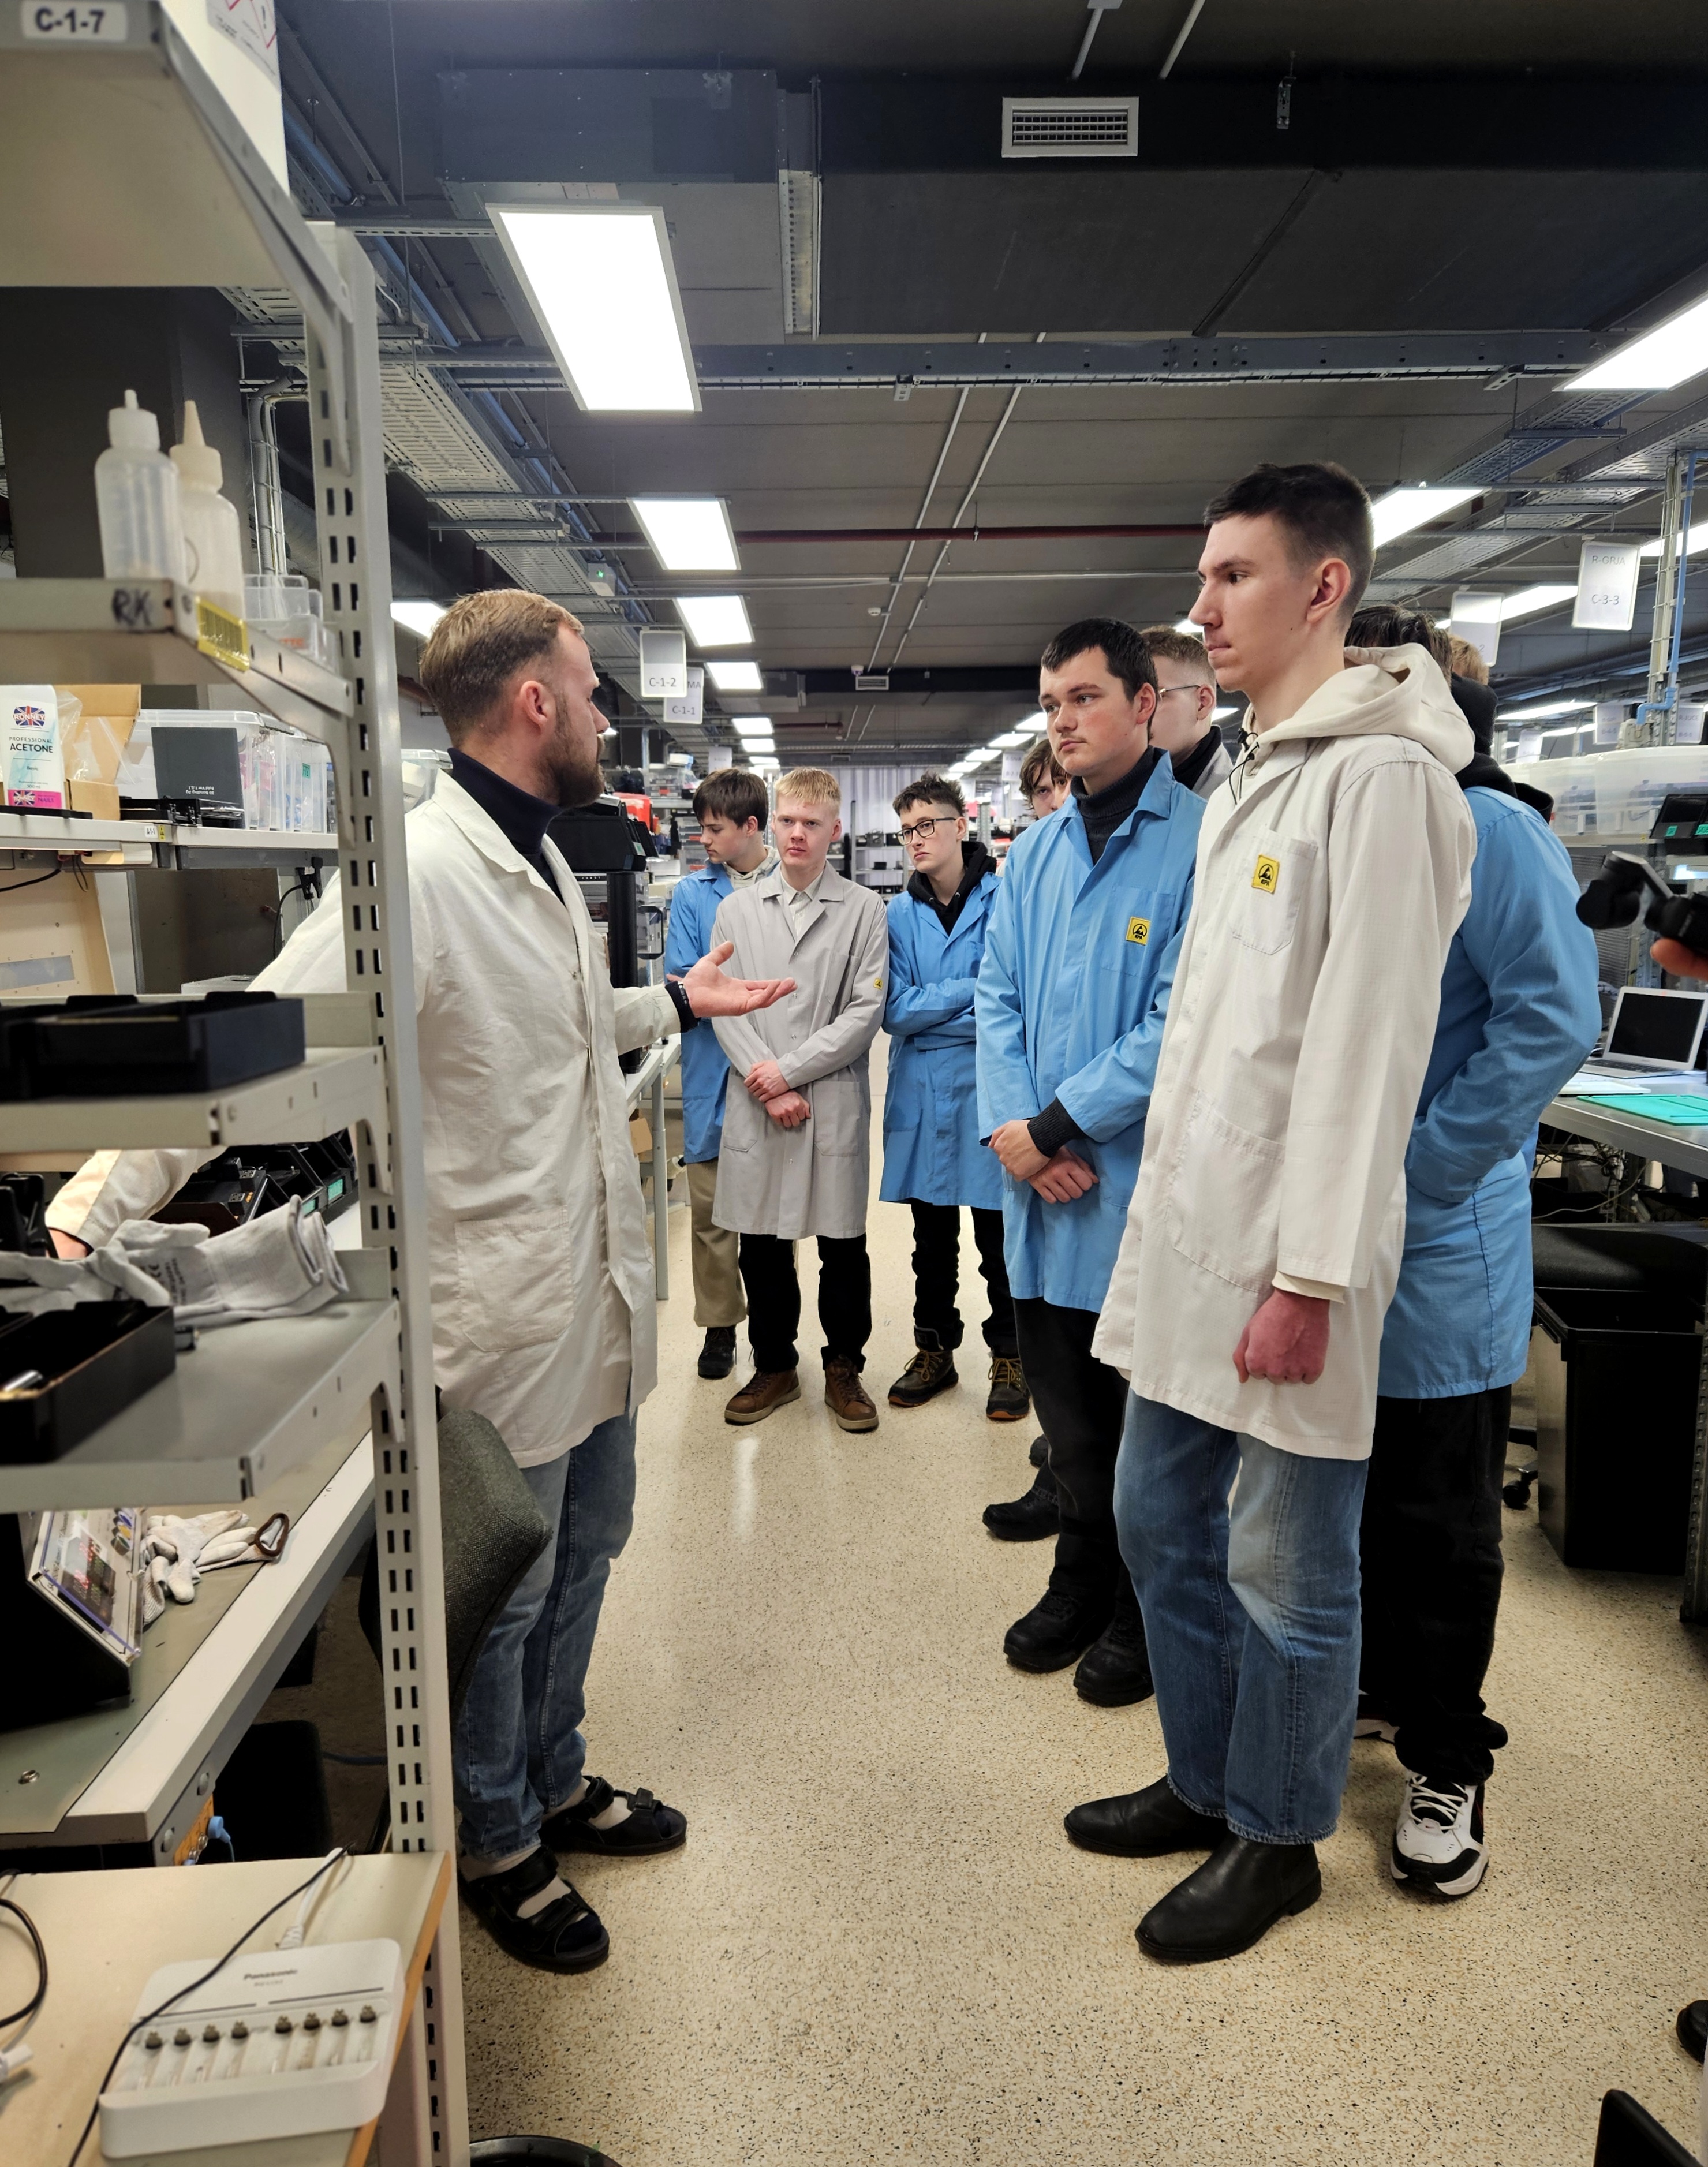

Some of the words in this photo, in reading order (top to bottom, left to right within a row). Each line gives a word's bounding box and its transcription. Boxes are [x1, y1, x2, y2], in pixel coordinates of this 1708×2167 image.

[35, 6, 105, 34] C-1-7
[1591, 555, 1625, 565] R-GRJA
[1591, 594, 1620, 606] C-3-3
[111, 588, 151, 626] RK
[649, 677, 677, 687] C-1-2
[672, 705, 696, 715] C-1-1
[13, 713, 46, 722] RONNEY
[10, 743, 53, 753] ACETONE
